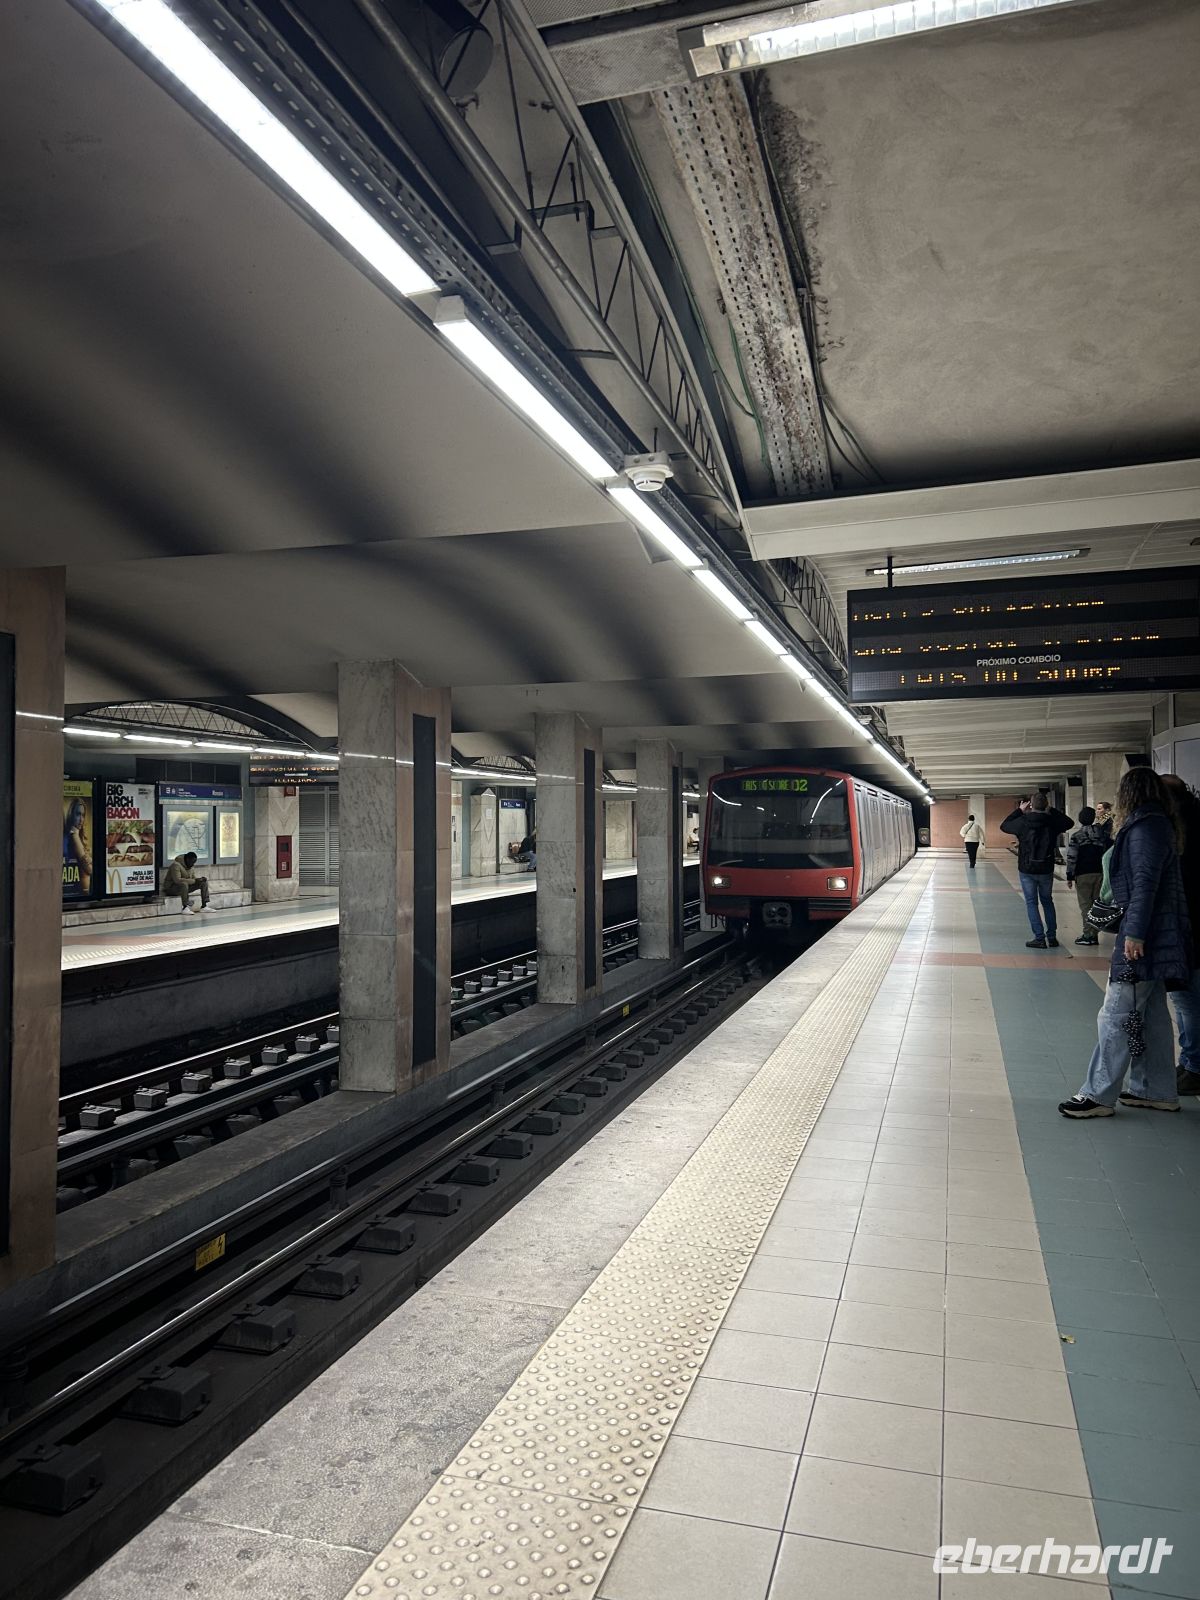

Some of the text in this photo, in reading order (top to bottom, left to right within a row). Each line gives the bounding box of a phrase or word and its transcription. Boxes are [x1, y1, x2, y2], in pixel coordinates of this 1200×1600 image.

[976, 654, 1061, 667] PRÓXIMO COMBOIO
[107, 784, 124, 796] BIG
[107, 796, 134, 808] ARCH
[107, 807, 140, 819] BACON
